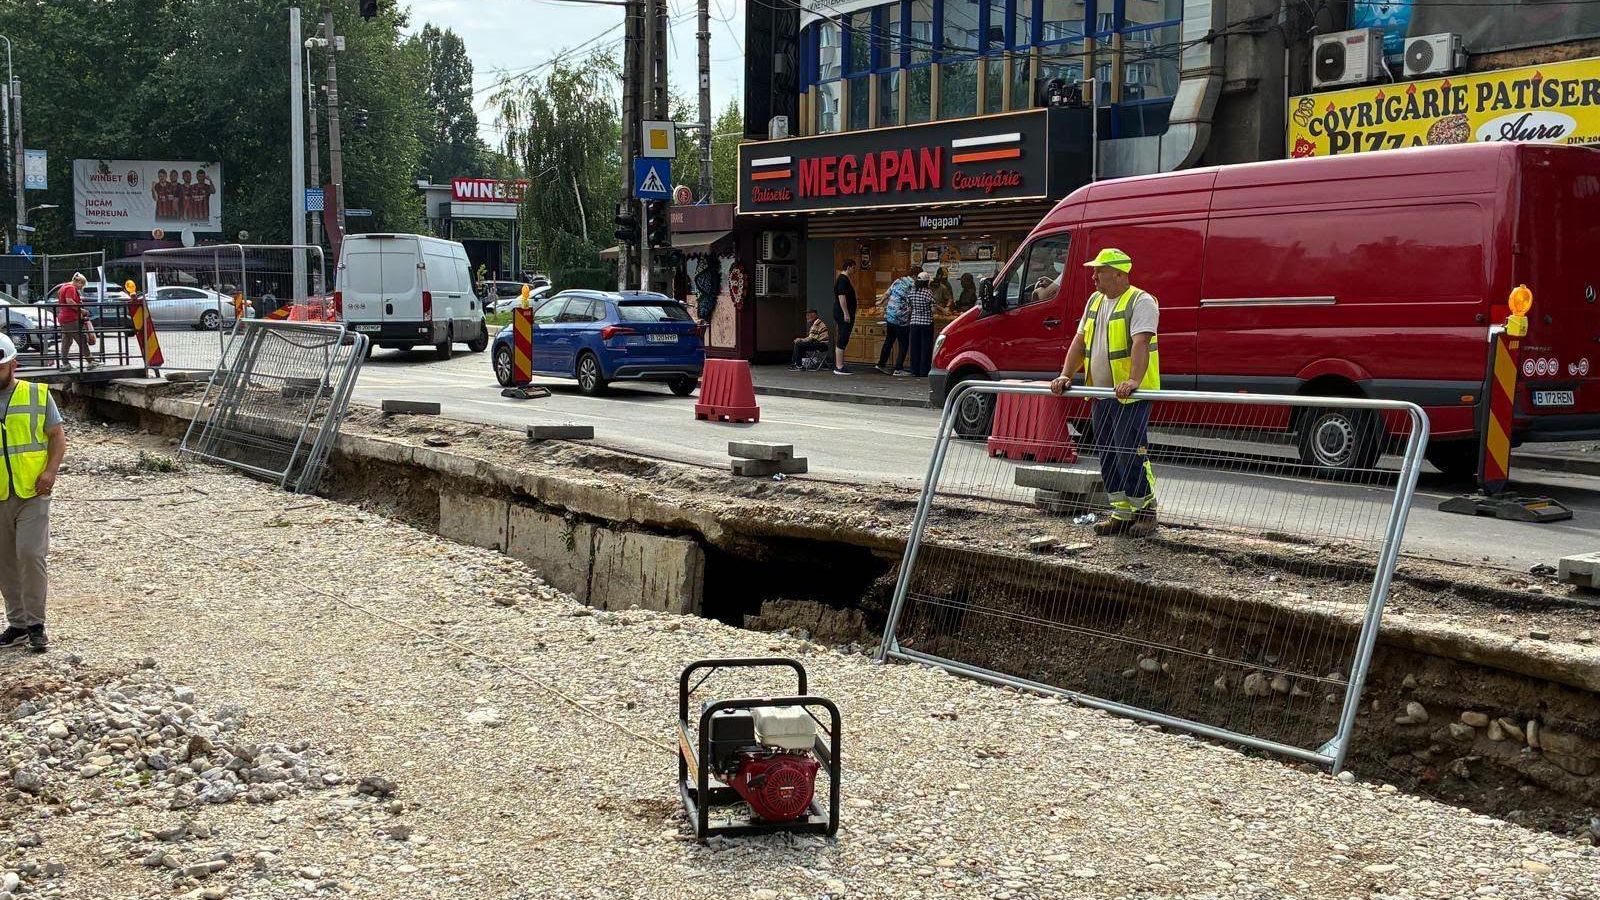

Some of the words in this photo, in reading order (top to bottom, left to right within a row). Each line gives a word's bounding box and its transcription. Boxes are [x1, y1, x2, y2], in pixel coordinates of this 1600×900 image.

[1485, 112, 1565, 142] Aura
[1567, 136, 1585, 144] DIN
[799, 146, 941, 197] MEGAPAN
[90, 174, 122, 182] WINBET
[1537, 392, 1543, 404] B
